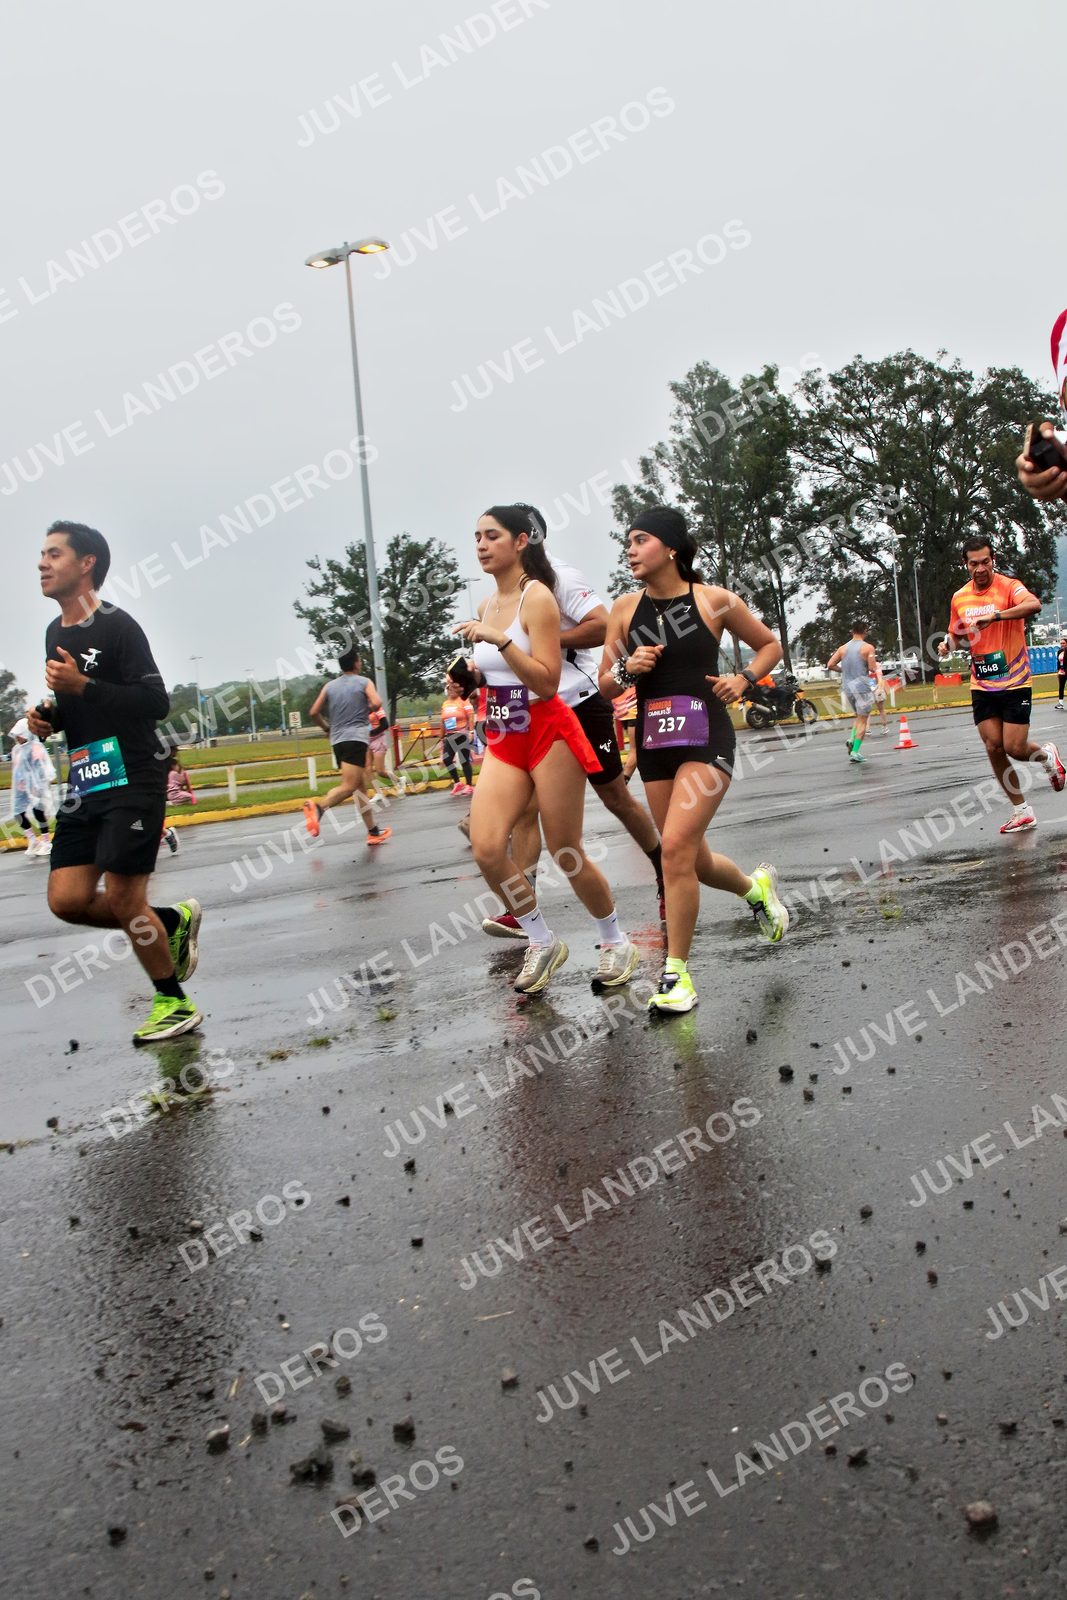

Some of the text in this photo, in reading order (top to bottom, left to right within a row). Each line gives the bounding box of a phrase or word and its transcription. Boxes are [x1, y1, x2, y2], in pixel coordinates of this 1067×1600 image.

[965, 603, 995, 617] CARRERA
[978, 663, 999, 674] 1648
[490, 705, 510, 719] 239
[658, 716, 686, 733] 237
[78, 761, 110, 781] 1488
